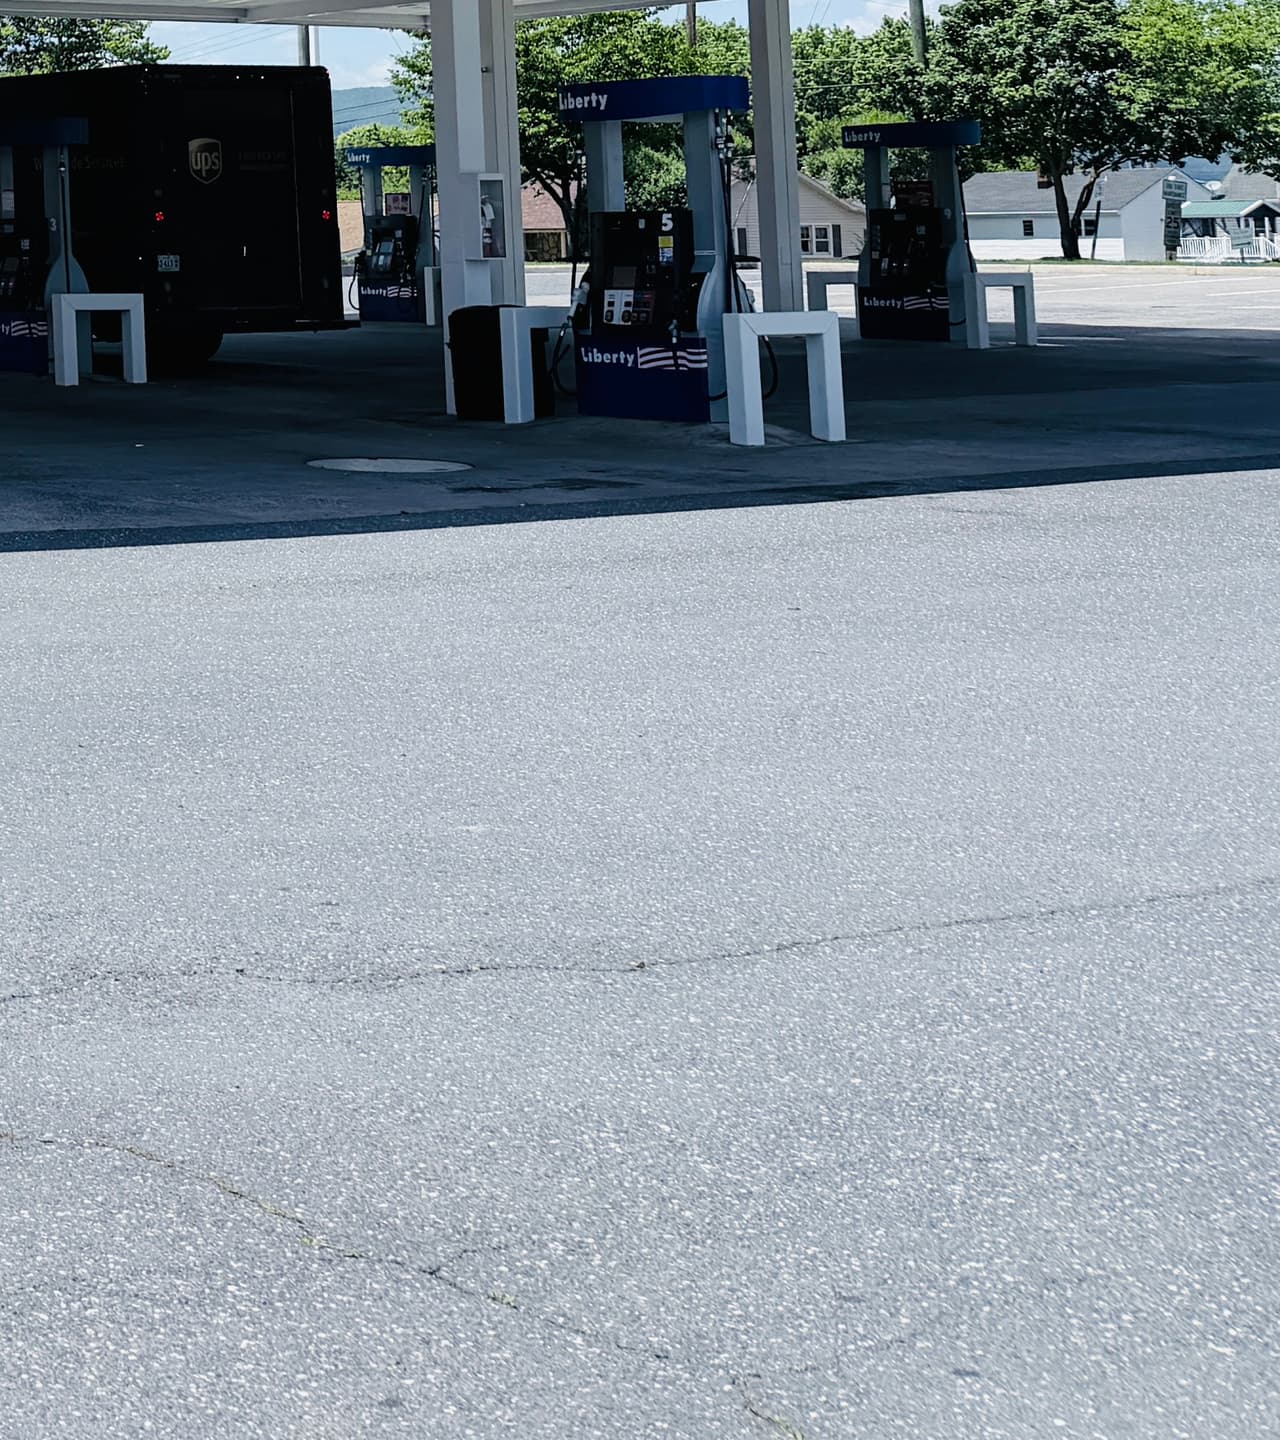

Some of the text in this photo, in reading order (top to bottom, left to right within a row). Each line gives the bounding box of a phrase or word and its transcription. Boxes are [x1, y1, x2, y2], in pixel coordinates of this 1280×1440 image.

[558, 92, 608, 110] Liberty
[844, 130, 881, 142] Liberty
[192, 152, 219, 177] ups
[49, 217, 57, 232] 3
[661, 213, 674, 231] 5
[1166, 216, 1180, 229] 25
[360, 286, 388, 298] Liberty
[863, 296, 902, 309] Liberty
[580, 346, 635, 366] Liberty
